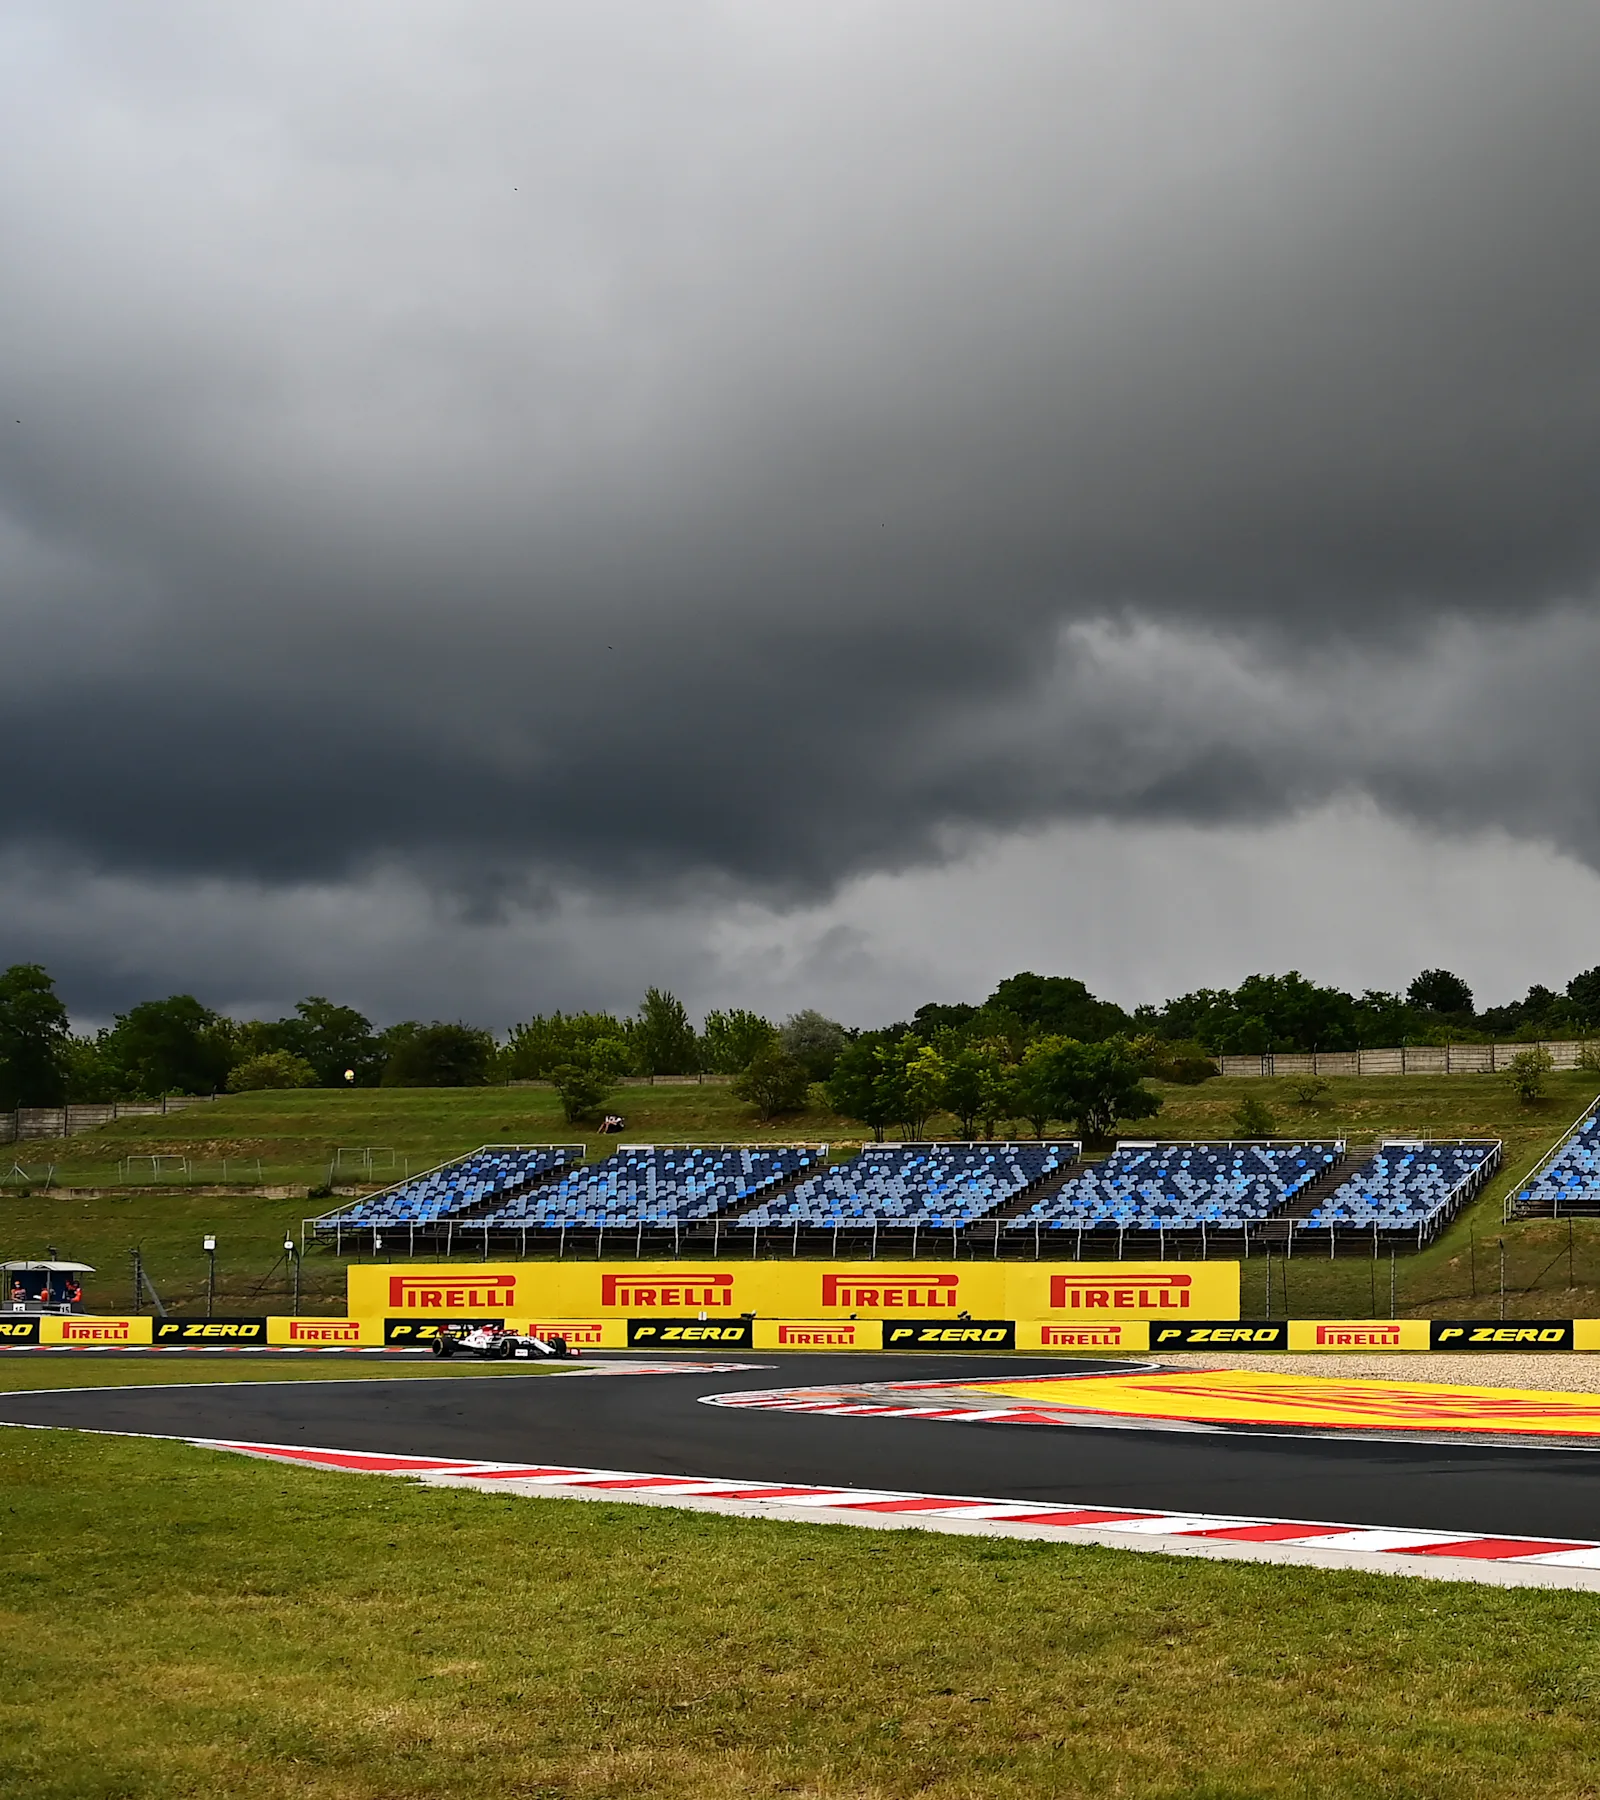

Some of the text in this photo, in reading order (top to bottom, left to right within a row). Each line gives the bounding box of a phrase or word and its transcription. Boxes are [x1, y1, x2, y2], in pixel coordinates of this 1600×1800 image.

[388, 1275, 517, 1308] PIRELLI
[601, 1274, 735, 1307] PIRELLI
[821, 1274, 960, 1307] PIRELLI
[1049, 1274, 1193, 1308] PIRELLI
[61, 1322, 130, 1340] PIRELLI
[158, 1324, 261, 1337] P ZERO
[289, 1322, 361, 1341] PIRELLI
[391, 1325, 412, 1338] P
[634, 1327, 745, 1341] P ZERO
[778, 1325, 856, 1345] PIRELLI
[890, 1328, 1008, 1342] P ZERO
[1040, 1326, 1123, 1346] PIRELLI
[1157, 1328, 1280, 1343] P ZERO
[1315, 1325, 1401, 1346] PIRELLI
[1439, 1328, 1566, 1342] P ZERO
